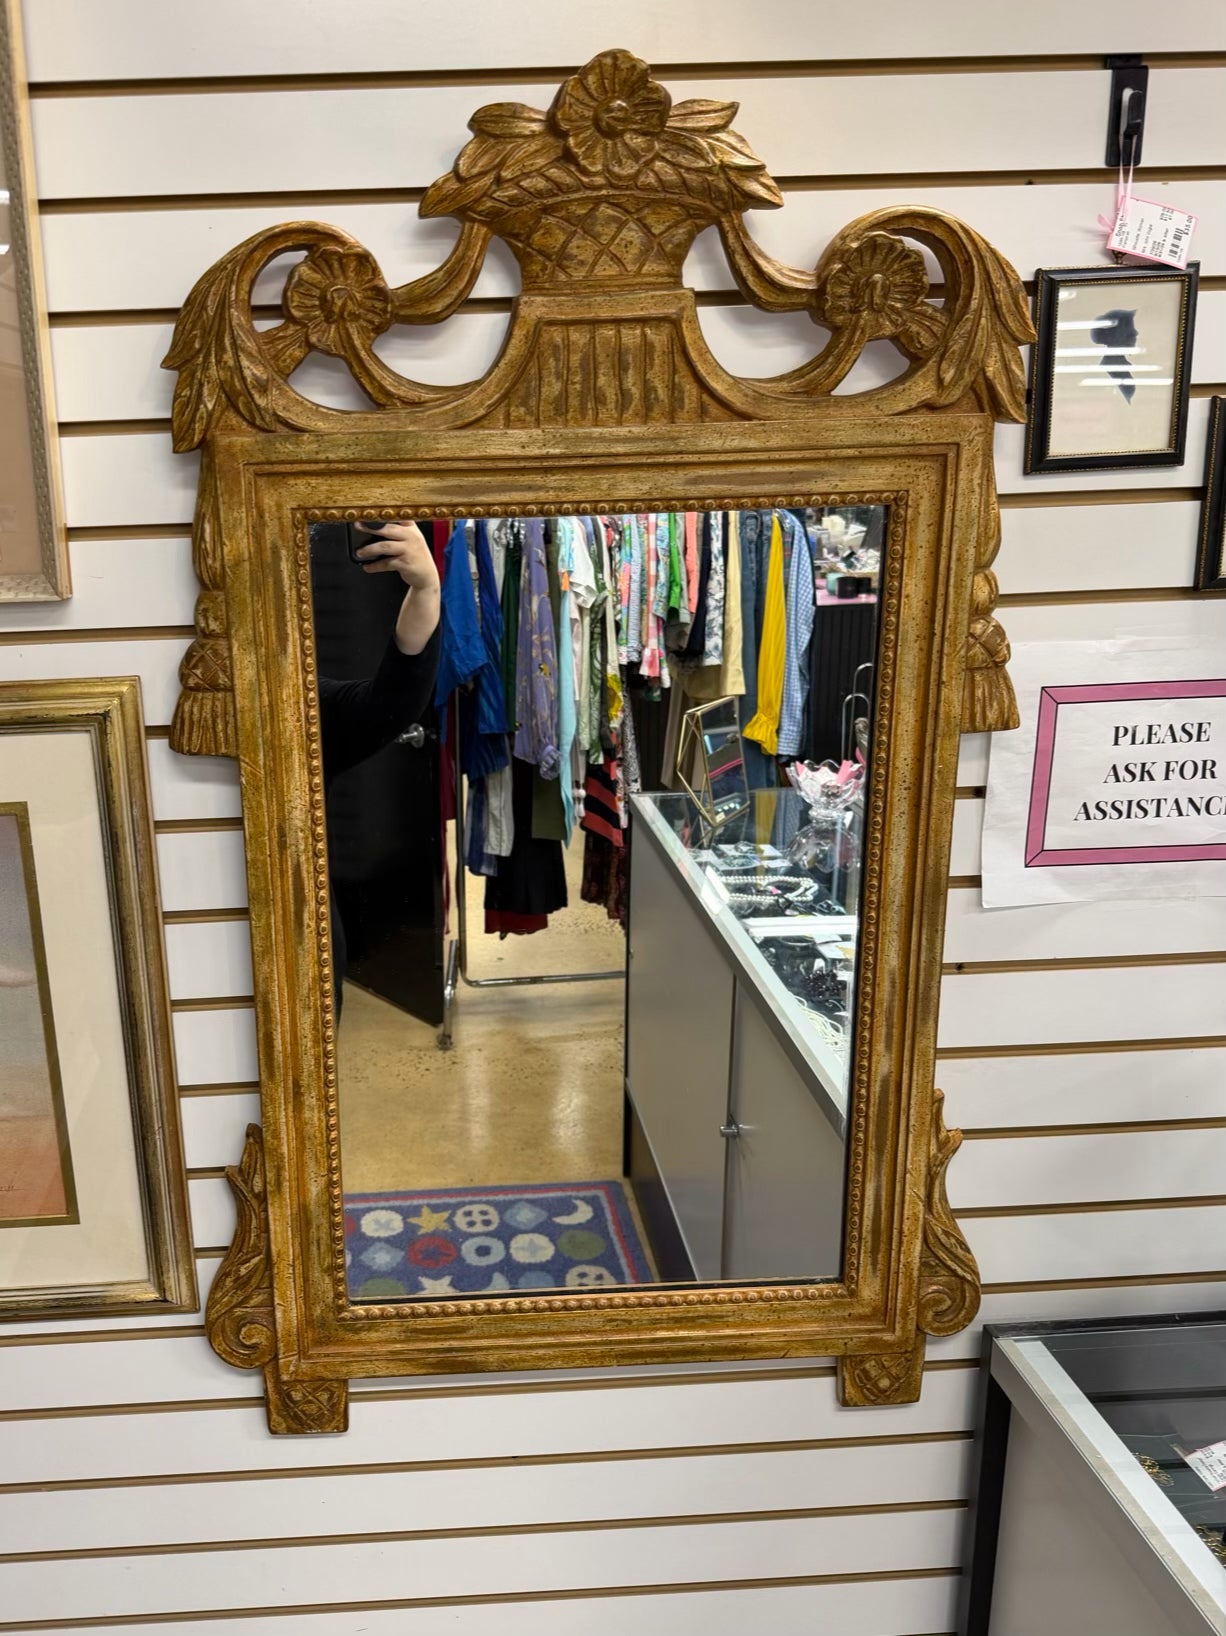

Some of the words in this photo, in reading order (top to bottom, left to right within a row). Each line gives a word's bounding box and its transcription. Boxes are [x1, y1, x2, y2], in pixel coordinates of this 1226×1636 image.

[1112, 722, 1211, 746] PLEASE
[1103, 762, 1157, 783] ASK
[1163, 759, 1217, 781] FOR
[1074, 796, 1226, 821] ASSISTANC
